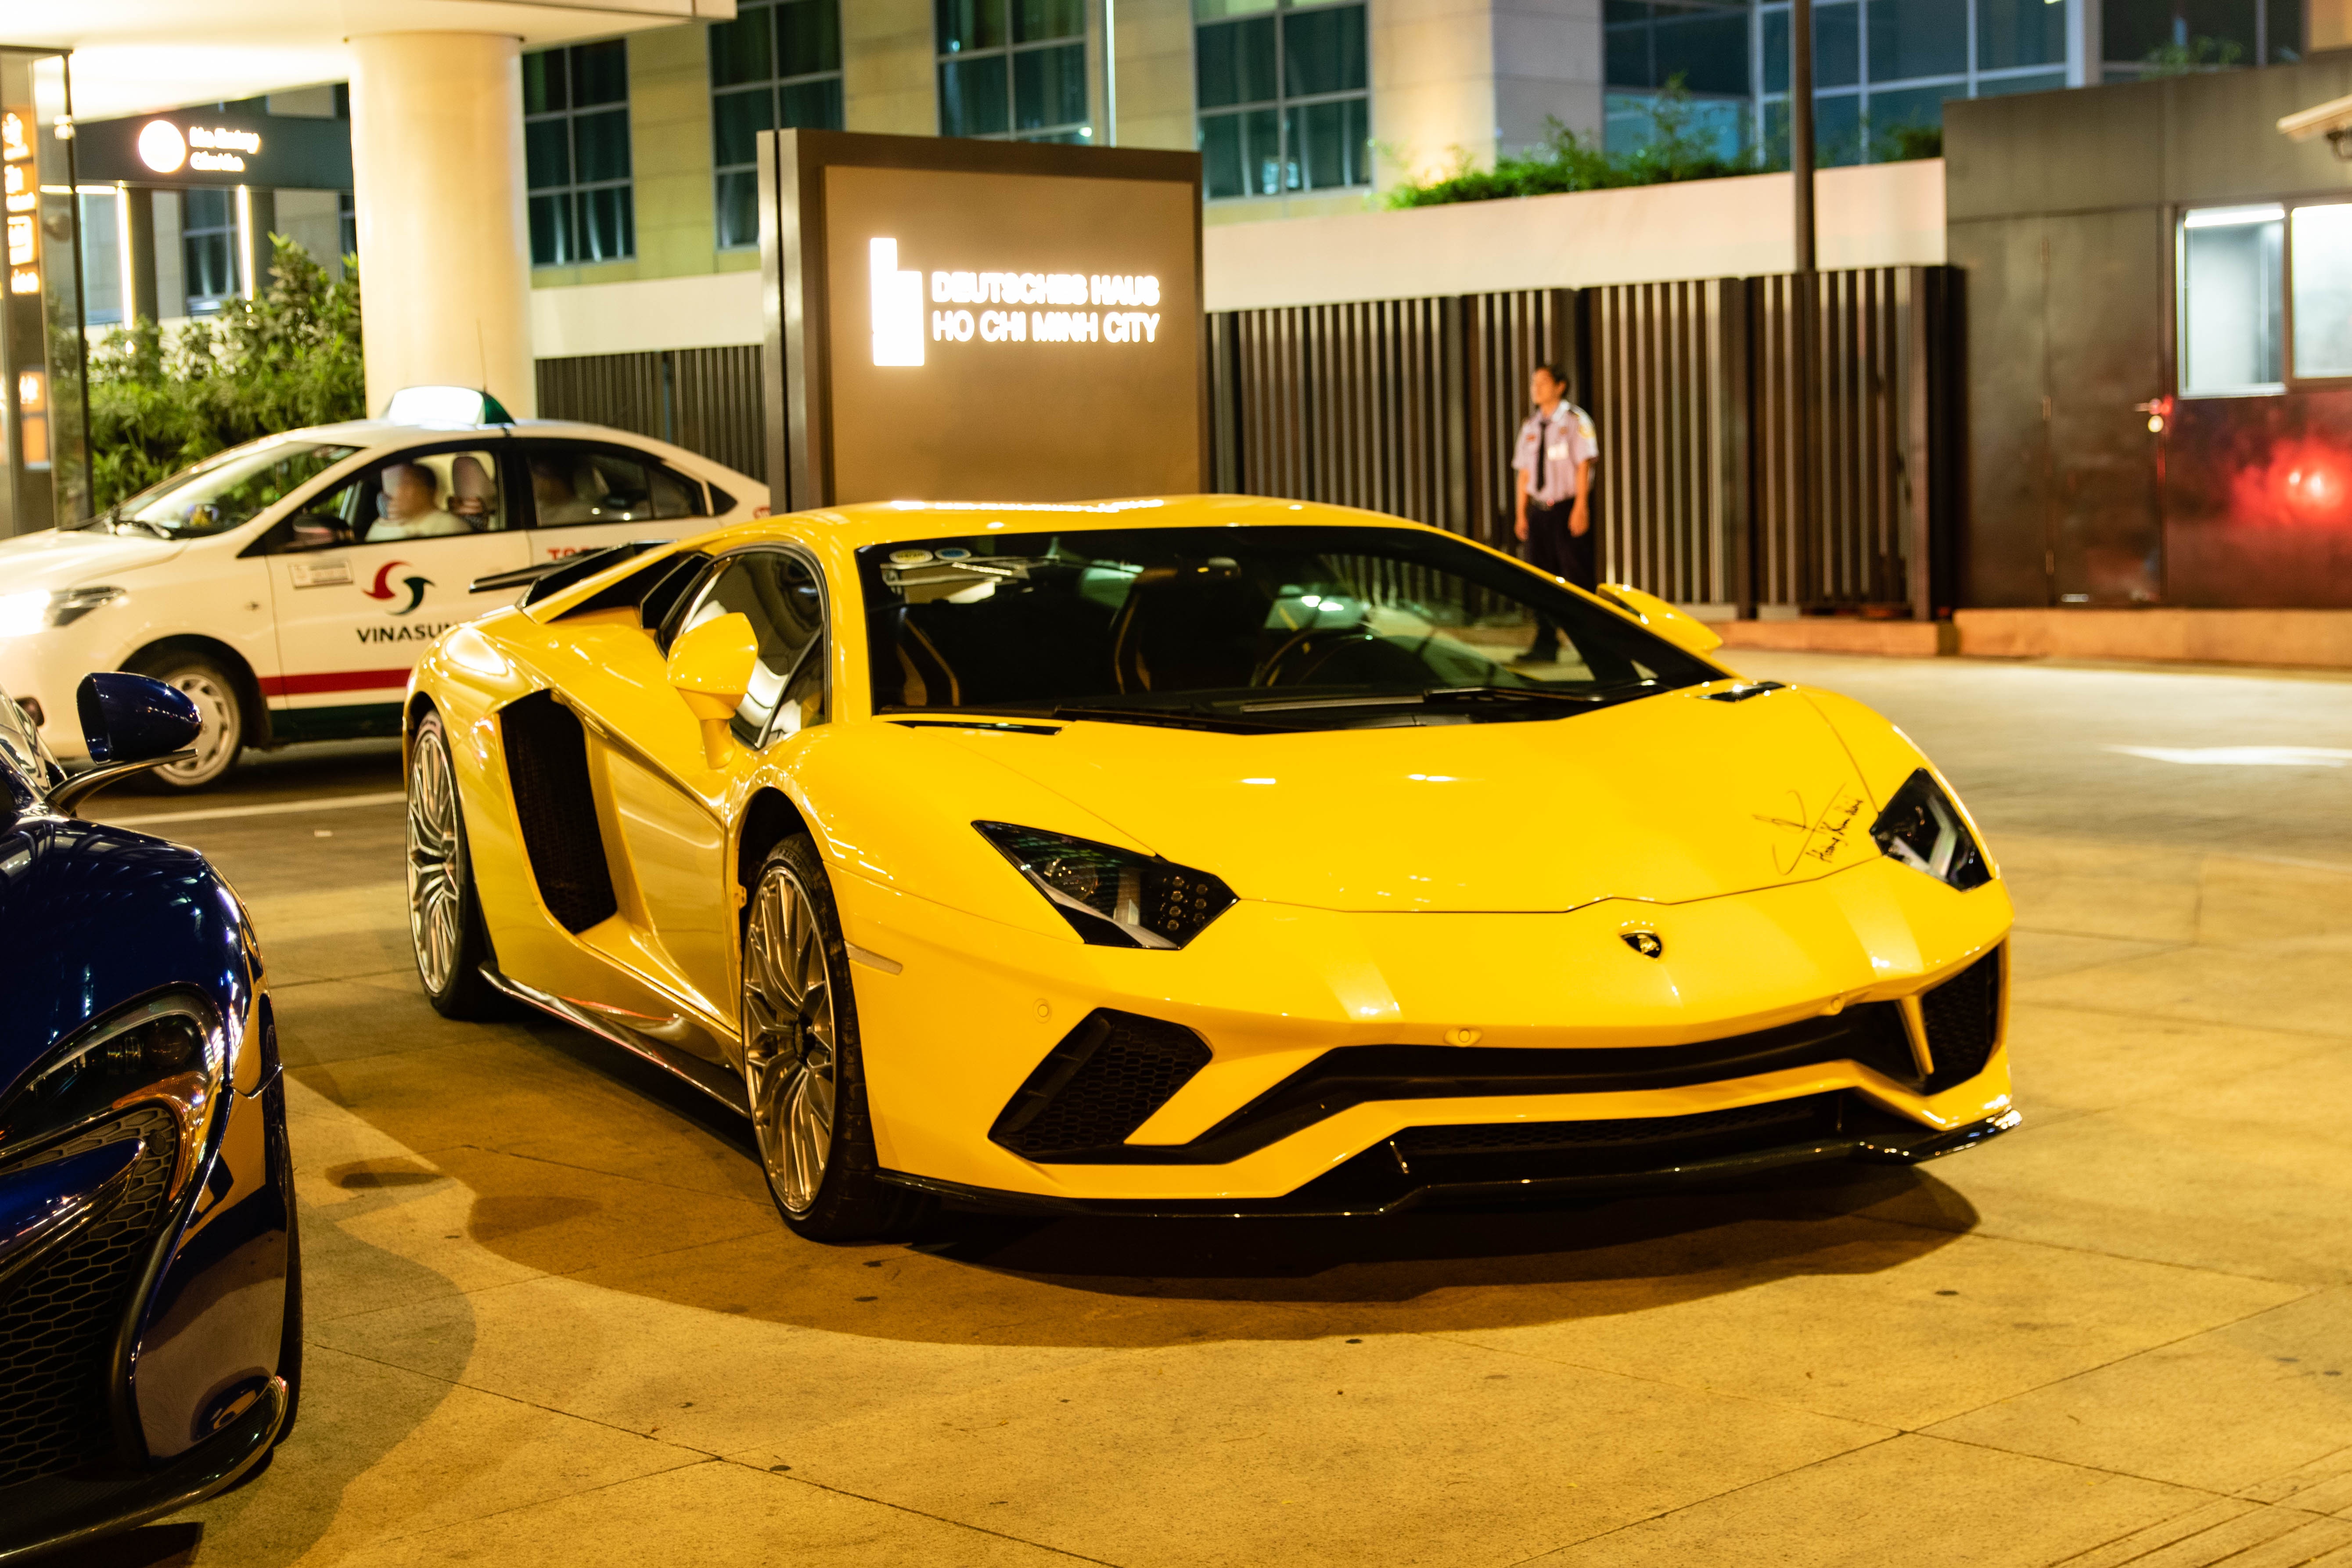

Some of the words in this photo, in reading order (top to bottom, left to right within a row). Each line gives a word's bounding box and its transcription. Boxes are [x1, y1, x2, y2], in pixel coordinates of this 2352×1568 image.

[932, 271, 1089, 305] DEUTSCHES
[1090, 275, 1160, 306] HAUS
[933, 309, 975, 342] HO
[980, 310, 1026, 342] CHI
[1032, 311, 1099, 342] MINH
[1103, 312, 1161, 343] CITY
